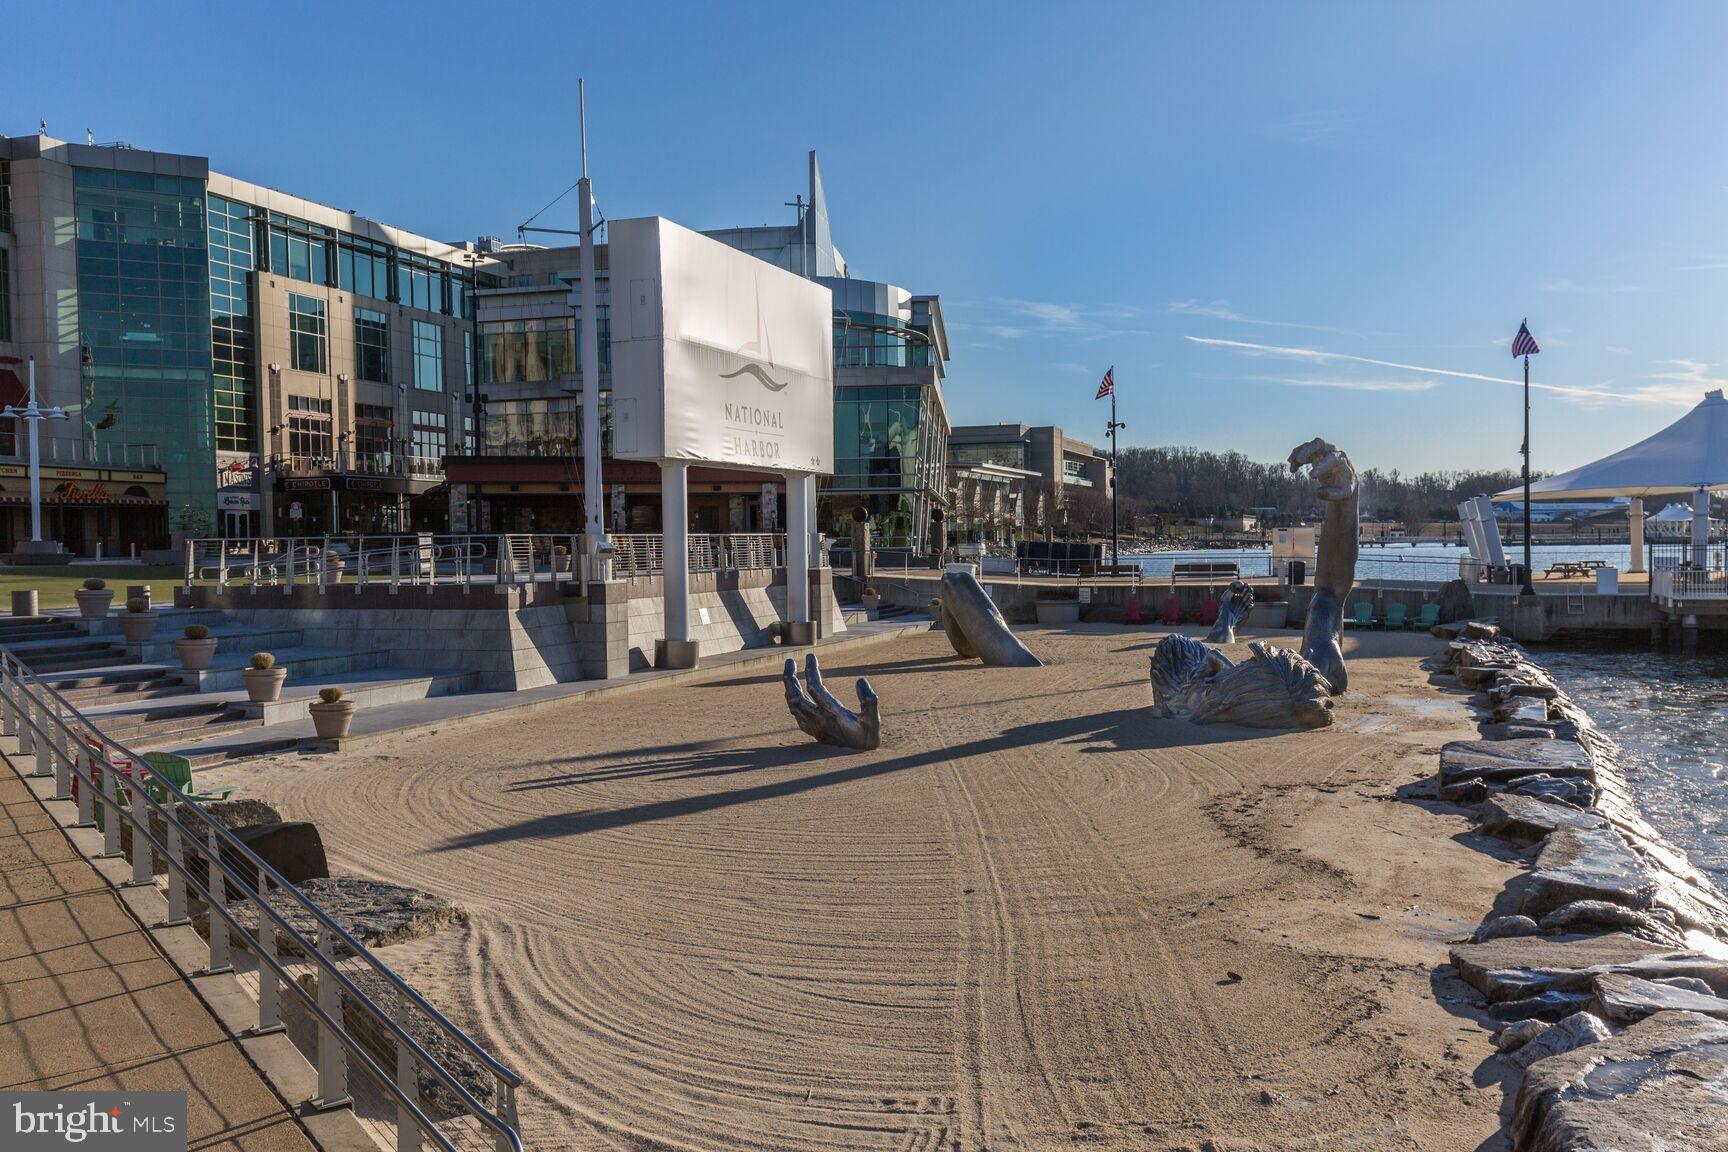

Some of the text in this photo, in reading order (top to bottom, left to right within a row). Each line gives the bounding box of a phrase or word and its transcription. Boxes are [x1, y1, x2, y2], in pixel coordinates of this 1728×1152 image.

[725, 403, 783, 429] NATIONAL
[734, 437, 780, 459] HARBOR
[292, 480, 326, 488] CHIPOTLE
